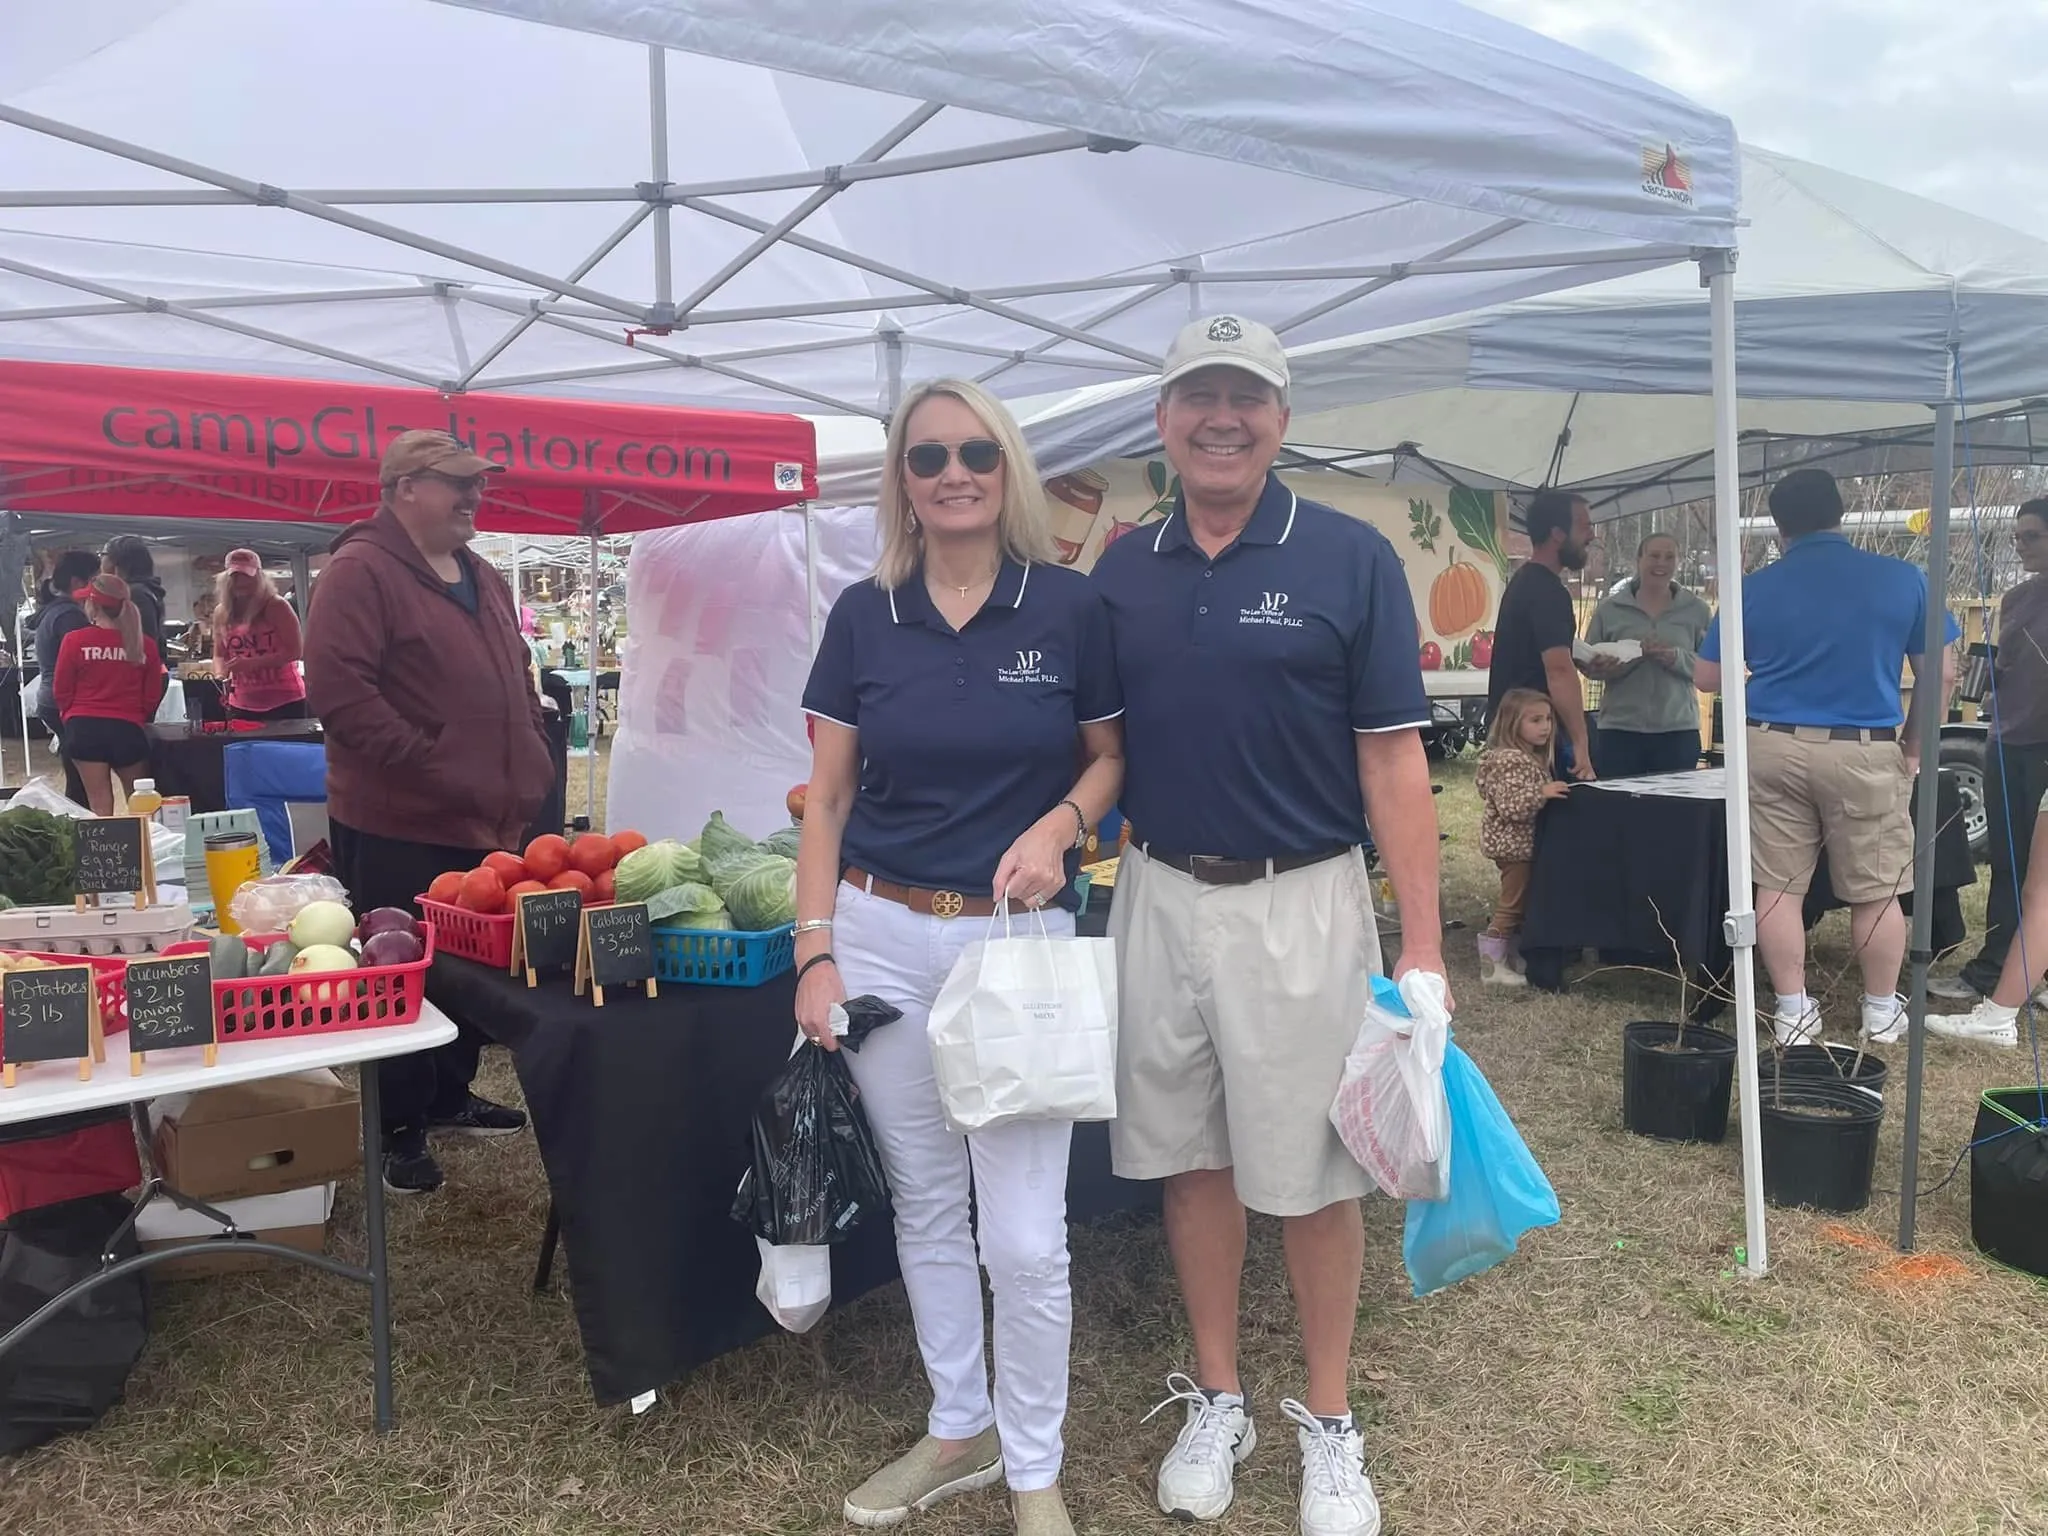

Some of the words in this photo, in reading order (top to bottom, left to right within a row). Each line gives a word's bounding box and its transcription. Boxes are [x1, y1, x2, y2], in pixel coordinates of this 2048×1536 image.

[102, 405, 732, 483] campGliator.com
[1239, 616, 1265, 624] Michael
[1283, 617, 1303, 627] PLLC
[1041, 674, 1059, 684] PLLC
[77, 821, 105, 840] Free
[88, 839, 129, 858] Range
[81, 855, 123, 869] eggs
[79, 879, 108, 890] Duck
[555, 912, 567, 924] lb
[591, 912, 643, 931] Cabbage
[618, 945, 641, 958] each
[129, 963, 201, 983] Cucumbers
[8, 978, 88, 1001] Potatoes
[168, 984, 185, 998] lb
[42, 1003, 64, 1023] lb
